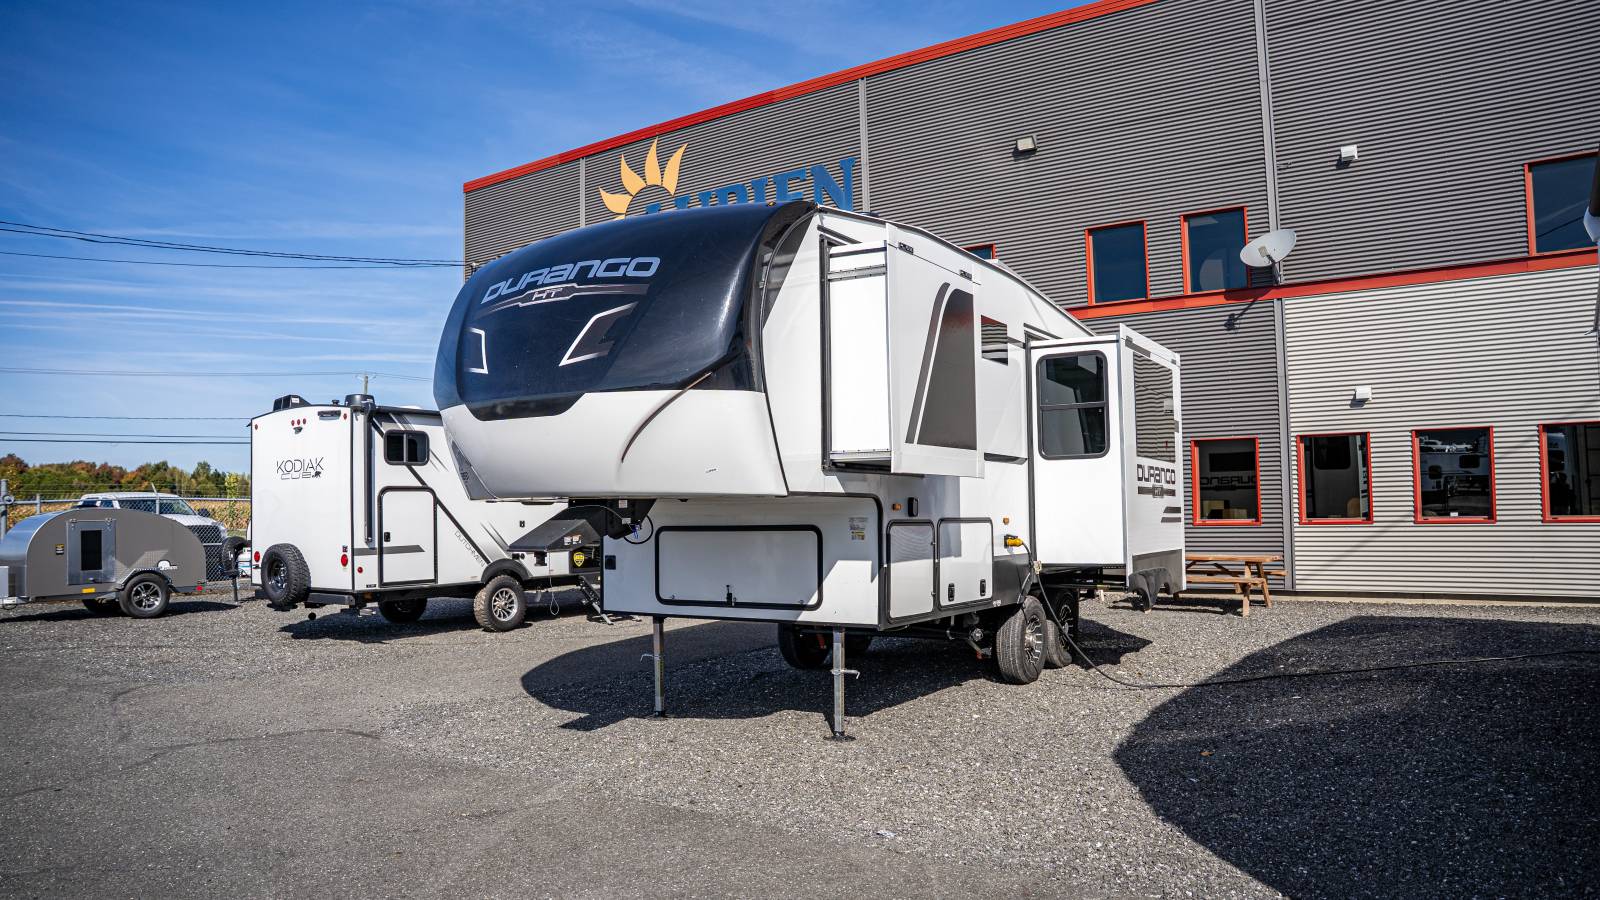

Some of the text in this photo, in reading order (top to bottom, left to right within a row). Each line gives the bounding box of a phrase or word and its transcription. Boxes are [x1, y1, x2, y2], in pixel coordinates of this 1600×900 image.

[481, 256, 661, 304] DURANGO
[532, 288, 563, 300] HT
[276, 456, 324, 474] KODIAK
[1136, 463, 1176, 485] DURANGO
[281, 471, 311, 481] CUB
